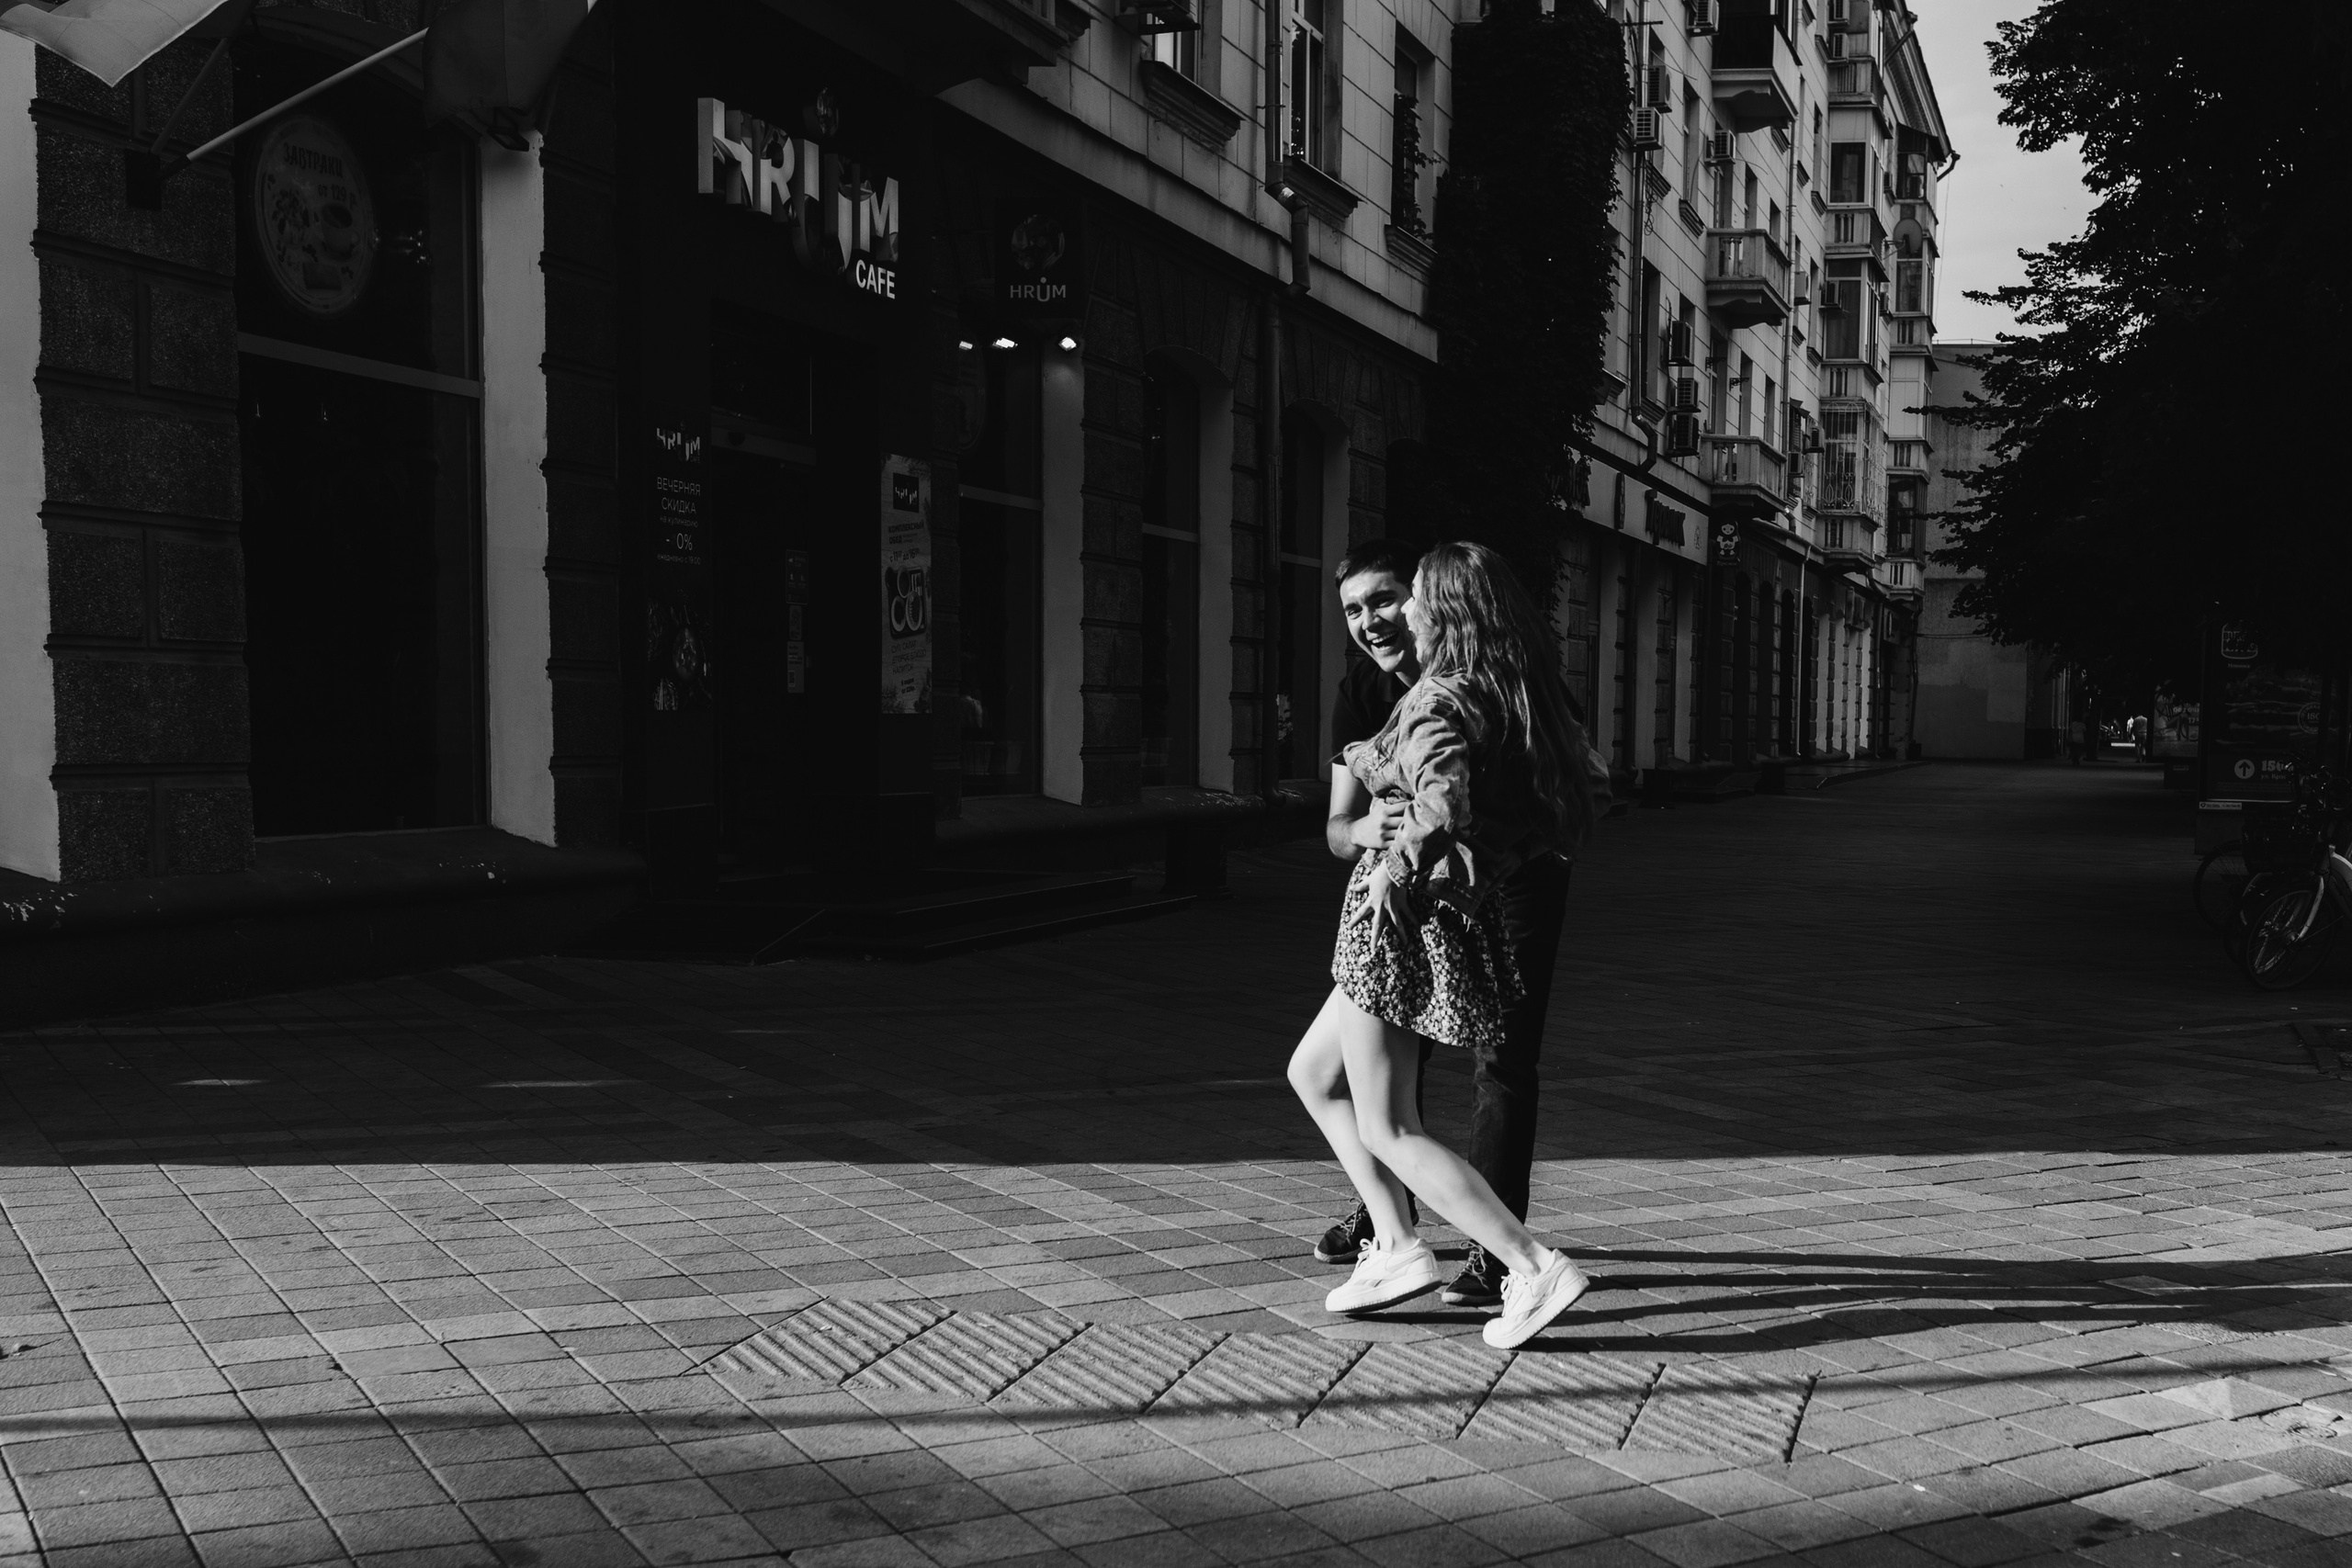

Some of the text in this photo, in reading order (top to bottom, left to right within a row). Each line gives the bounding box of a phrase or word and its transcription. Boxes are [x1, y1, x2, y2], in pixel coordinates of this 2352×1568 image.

[283, 142, 344, 178] ЗАВТРАКИ
[318, 184, 328, 197] от
[331, 184, 347, 202] 129
[854, 259, 897, 299] CAFE
[657, 477, 701, 496] ВЕЧЕРНЯЯ
[661, 497, 696, 514] СКИДКА
[888, 535, 902, 545] ОБЕД
